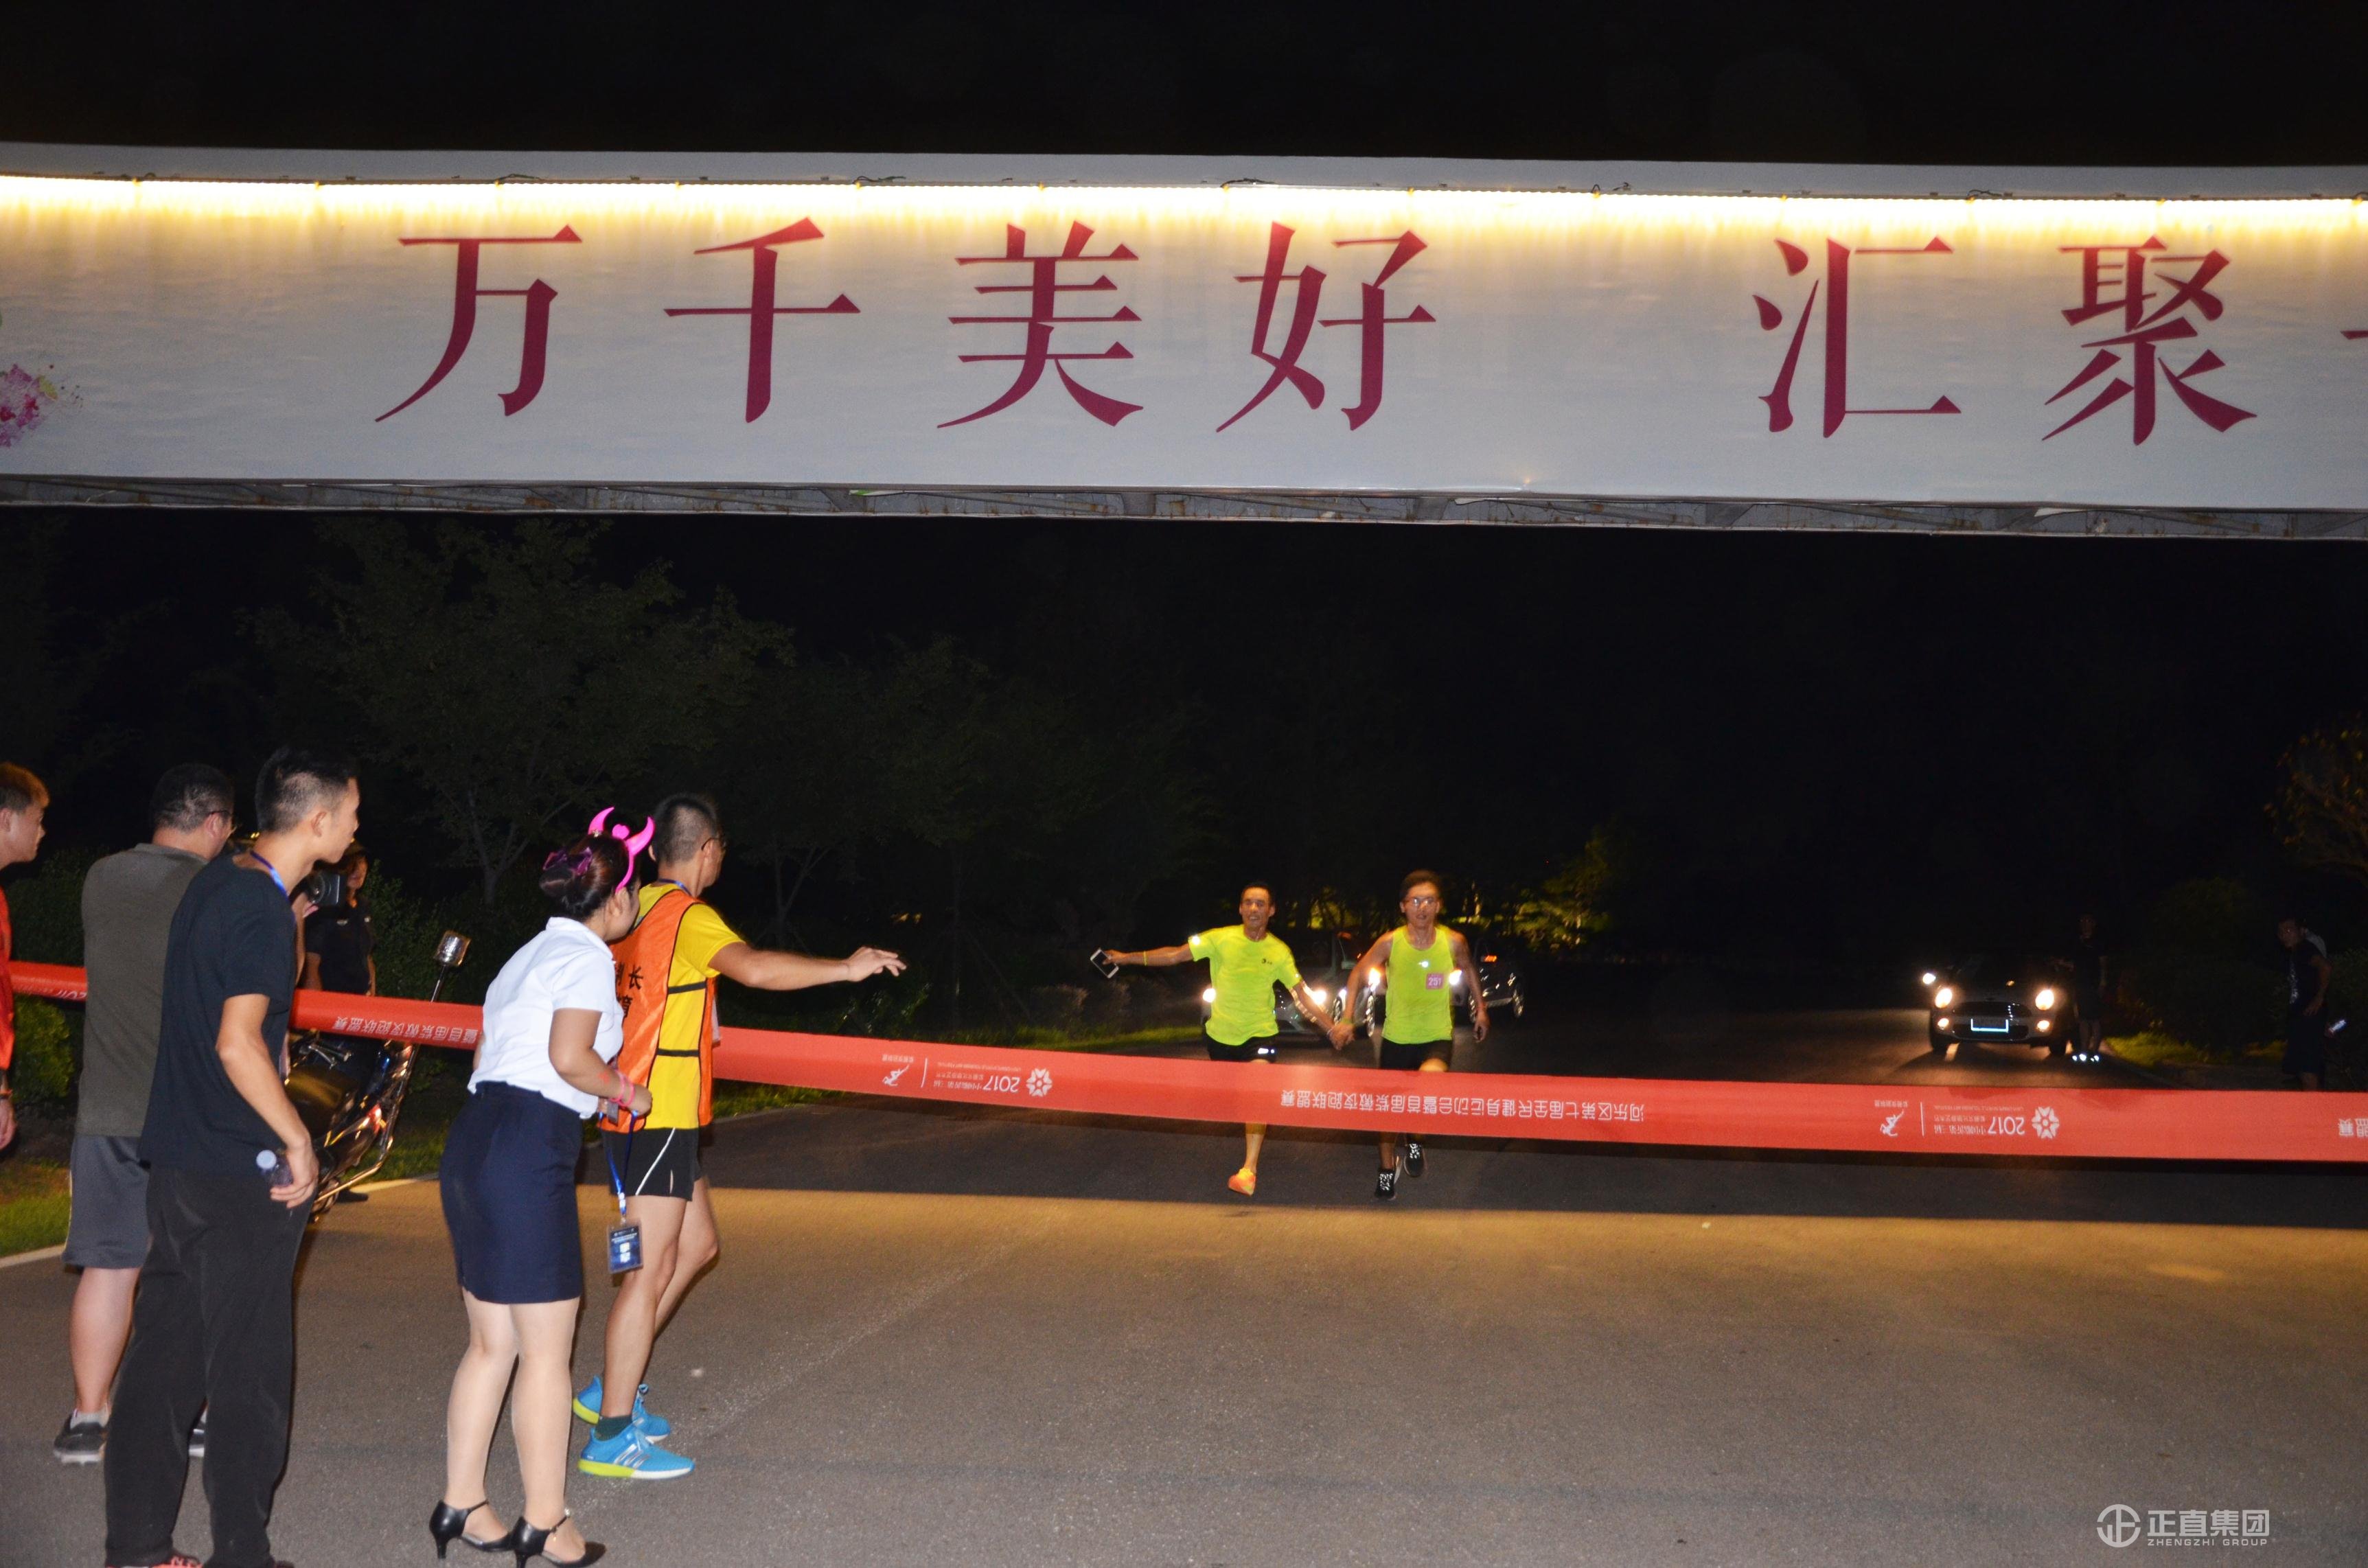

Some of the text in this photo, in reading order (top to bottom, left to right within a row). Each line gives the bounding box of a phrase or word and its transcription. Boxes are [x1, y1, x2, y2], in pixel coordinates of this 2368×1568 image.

[376, 217, 2368, 446] 万千美好 汇聚
[983, 1075, 1020, 1093] 2017
[1280, 1089, 1644, 1122] 河东区第七届全民健身运动会暨首届紫薇夜跑联盟赛
[1988, 1116, 2025, 1135] 2017
